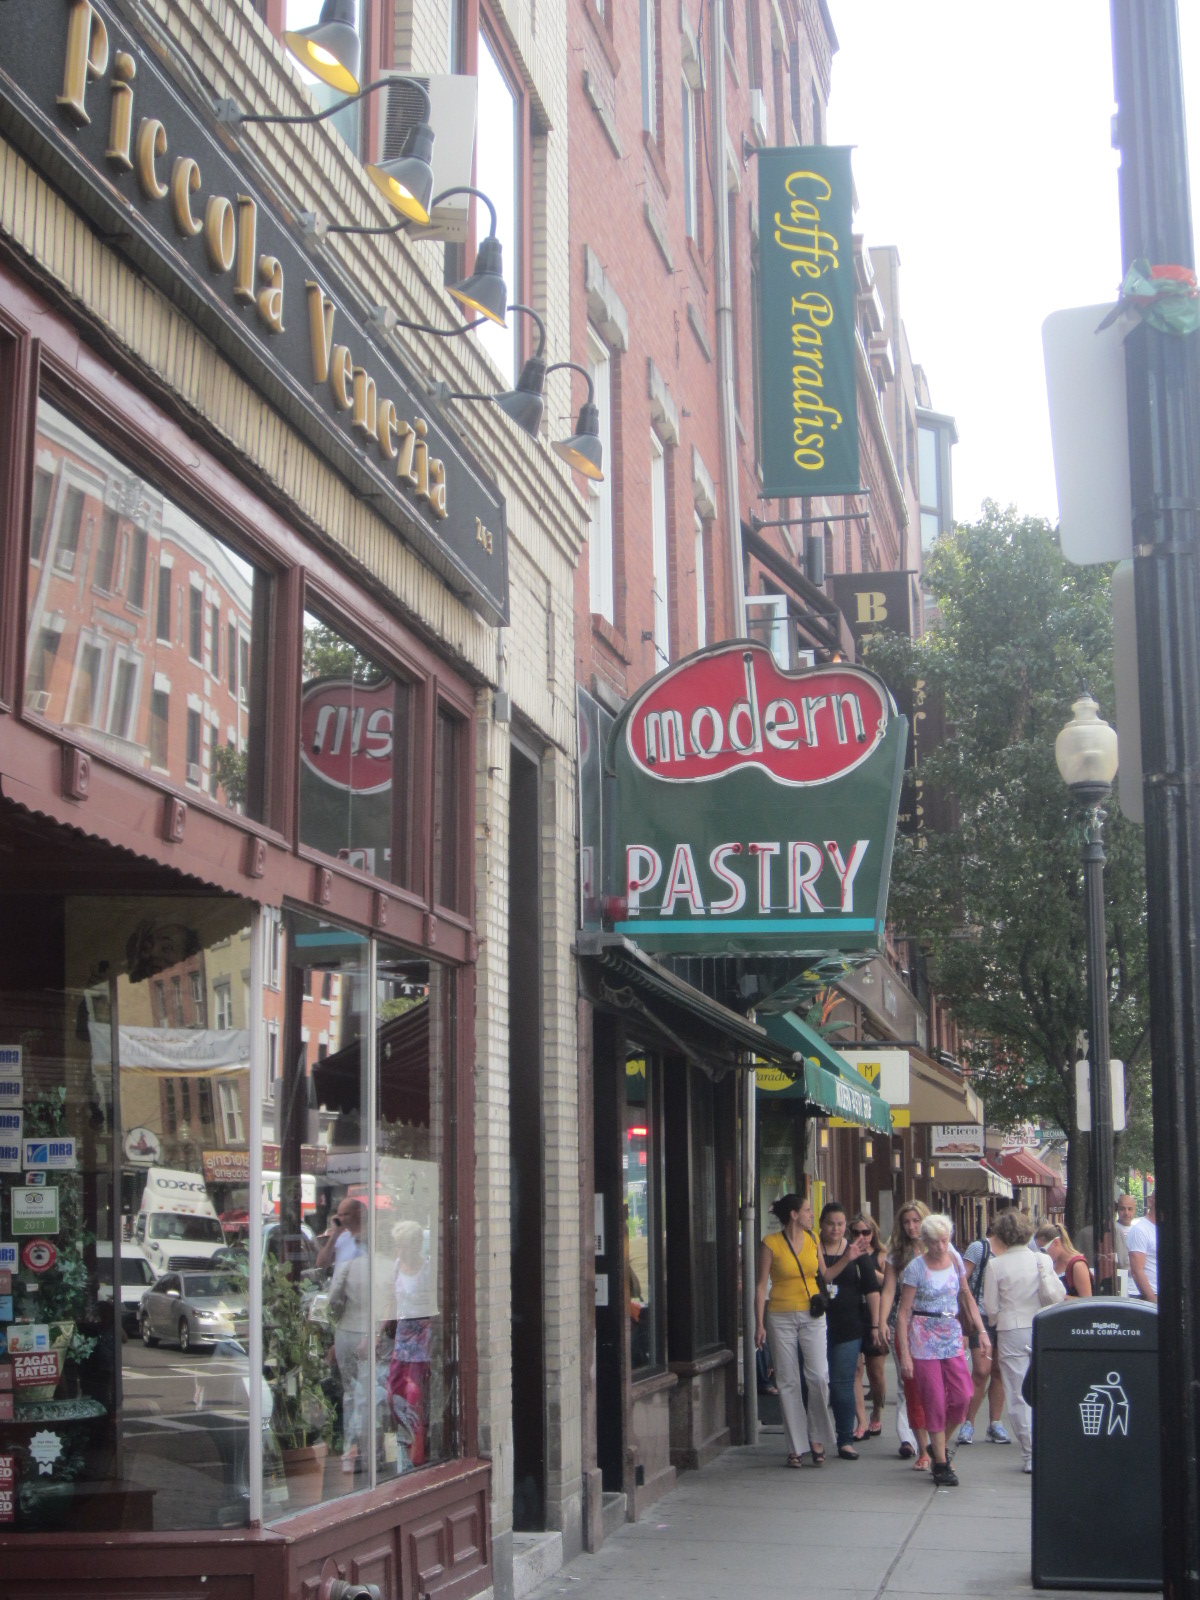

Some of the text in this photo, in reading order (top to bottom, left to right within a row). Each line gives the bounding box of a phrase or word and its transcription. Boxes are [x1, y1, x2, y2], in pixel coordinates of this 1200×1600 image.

[56, 0, 448, 519] Piccola Venezia
[774, 169, 843, 471] Caffè Paradiso
[643, 651, 866, 766] modern
[625, 839, 870, 916] PASTRY
[942, 1125, 978, 1135] Bricco
[1016, 1175, 1033, 1184] Vita
[1071, 1328, 1095, 1336] SOLAR
[1092, 1322, 1120, 1330] BigBelly
[14, 1354, 56, 1367] ZAGAT
[15, 1365, 57, 1378] RATED
